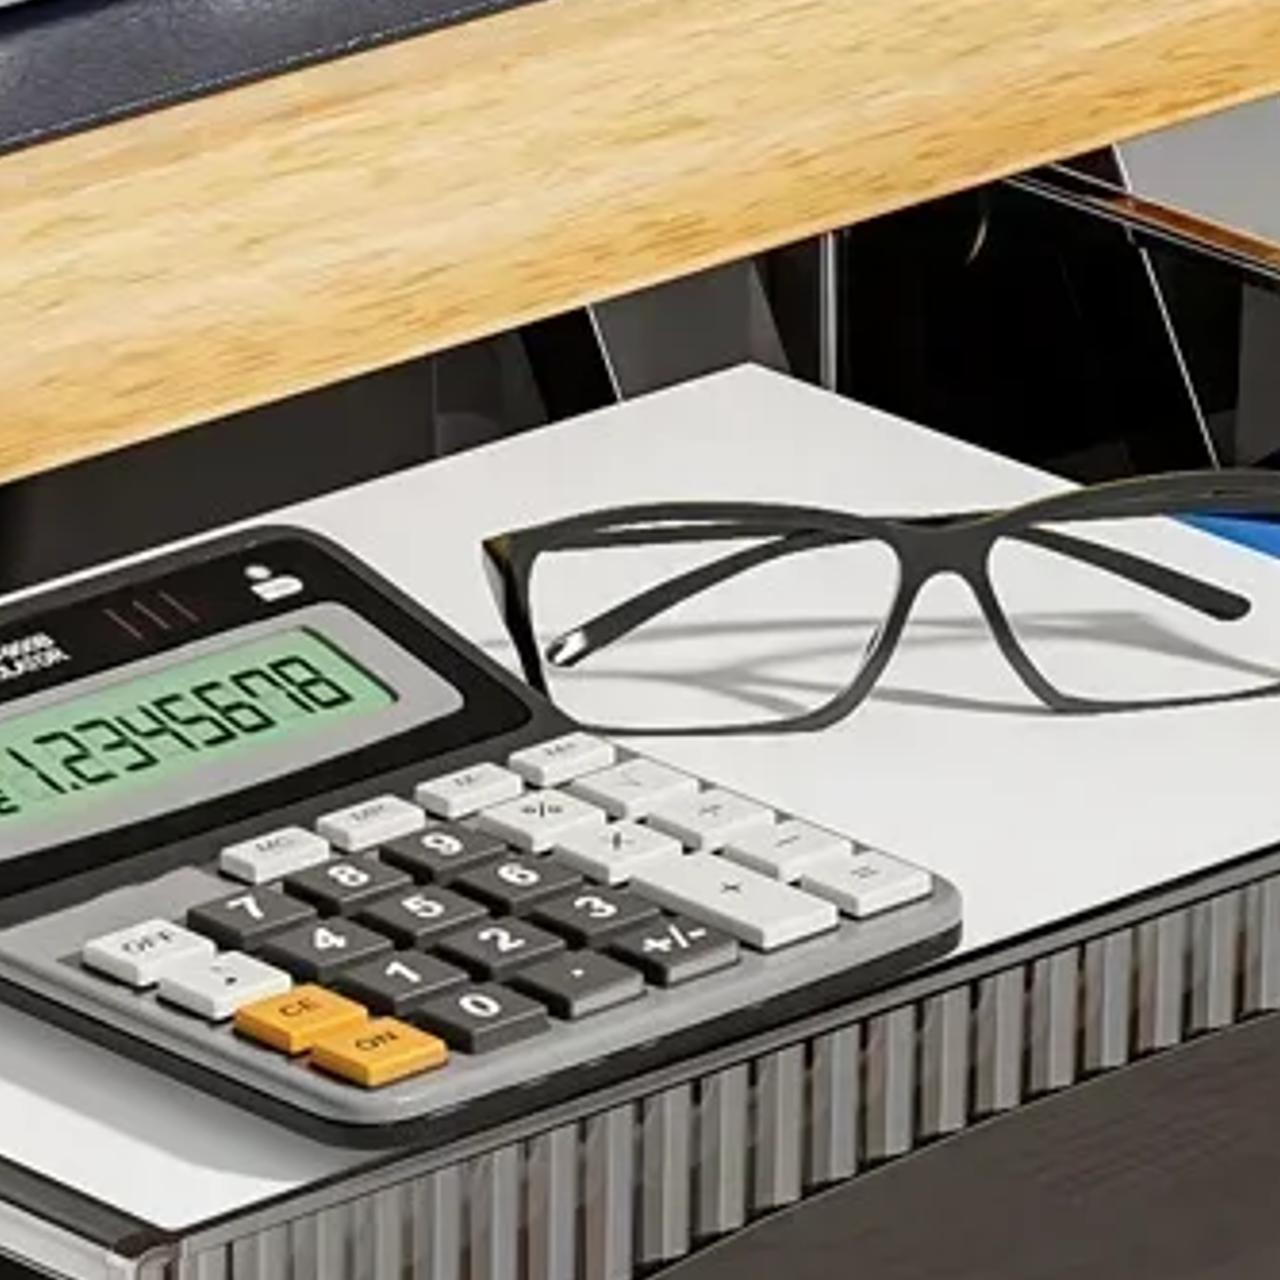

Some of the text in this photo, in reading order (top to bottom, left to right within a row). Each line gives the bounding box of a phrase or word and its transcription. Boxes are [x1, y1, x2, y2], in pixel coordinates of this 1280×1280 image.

[4, 655, 354, 796] 1.2345678
[421, 832, 463, 856] 9
[327, 865, 369, 887] 8
[497, 864, 540, 887] 6
[227, 895, 263, 919] 7
[401, 893, 444, 918] 5
[573, 895, 617, 918] 3
[313, 927, 347, 950] 4
[477, 927, 525, 953] 2
[642, 923, 707, 953] +/-
[385, 961, 421, 984] 1
[279, 995, 322, 1018] CE
[458, 992, 502, 1018] 0
